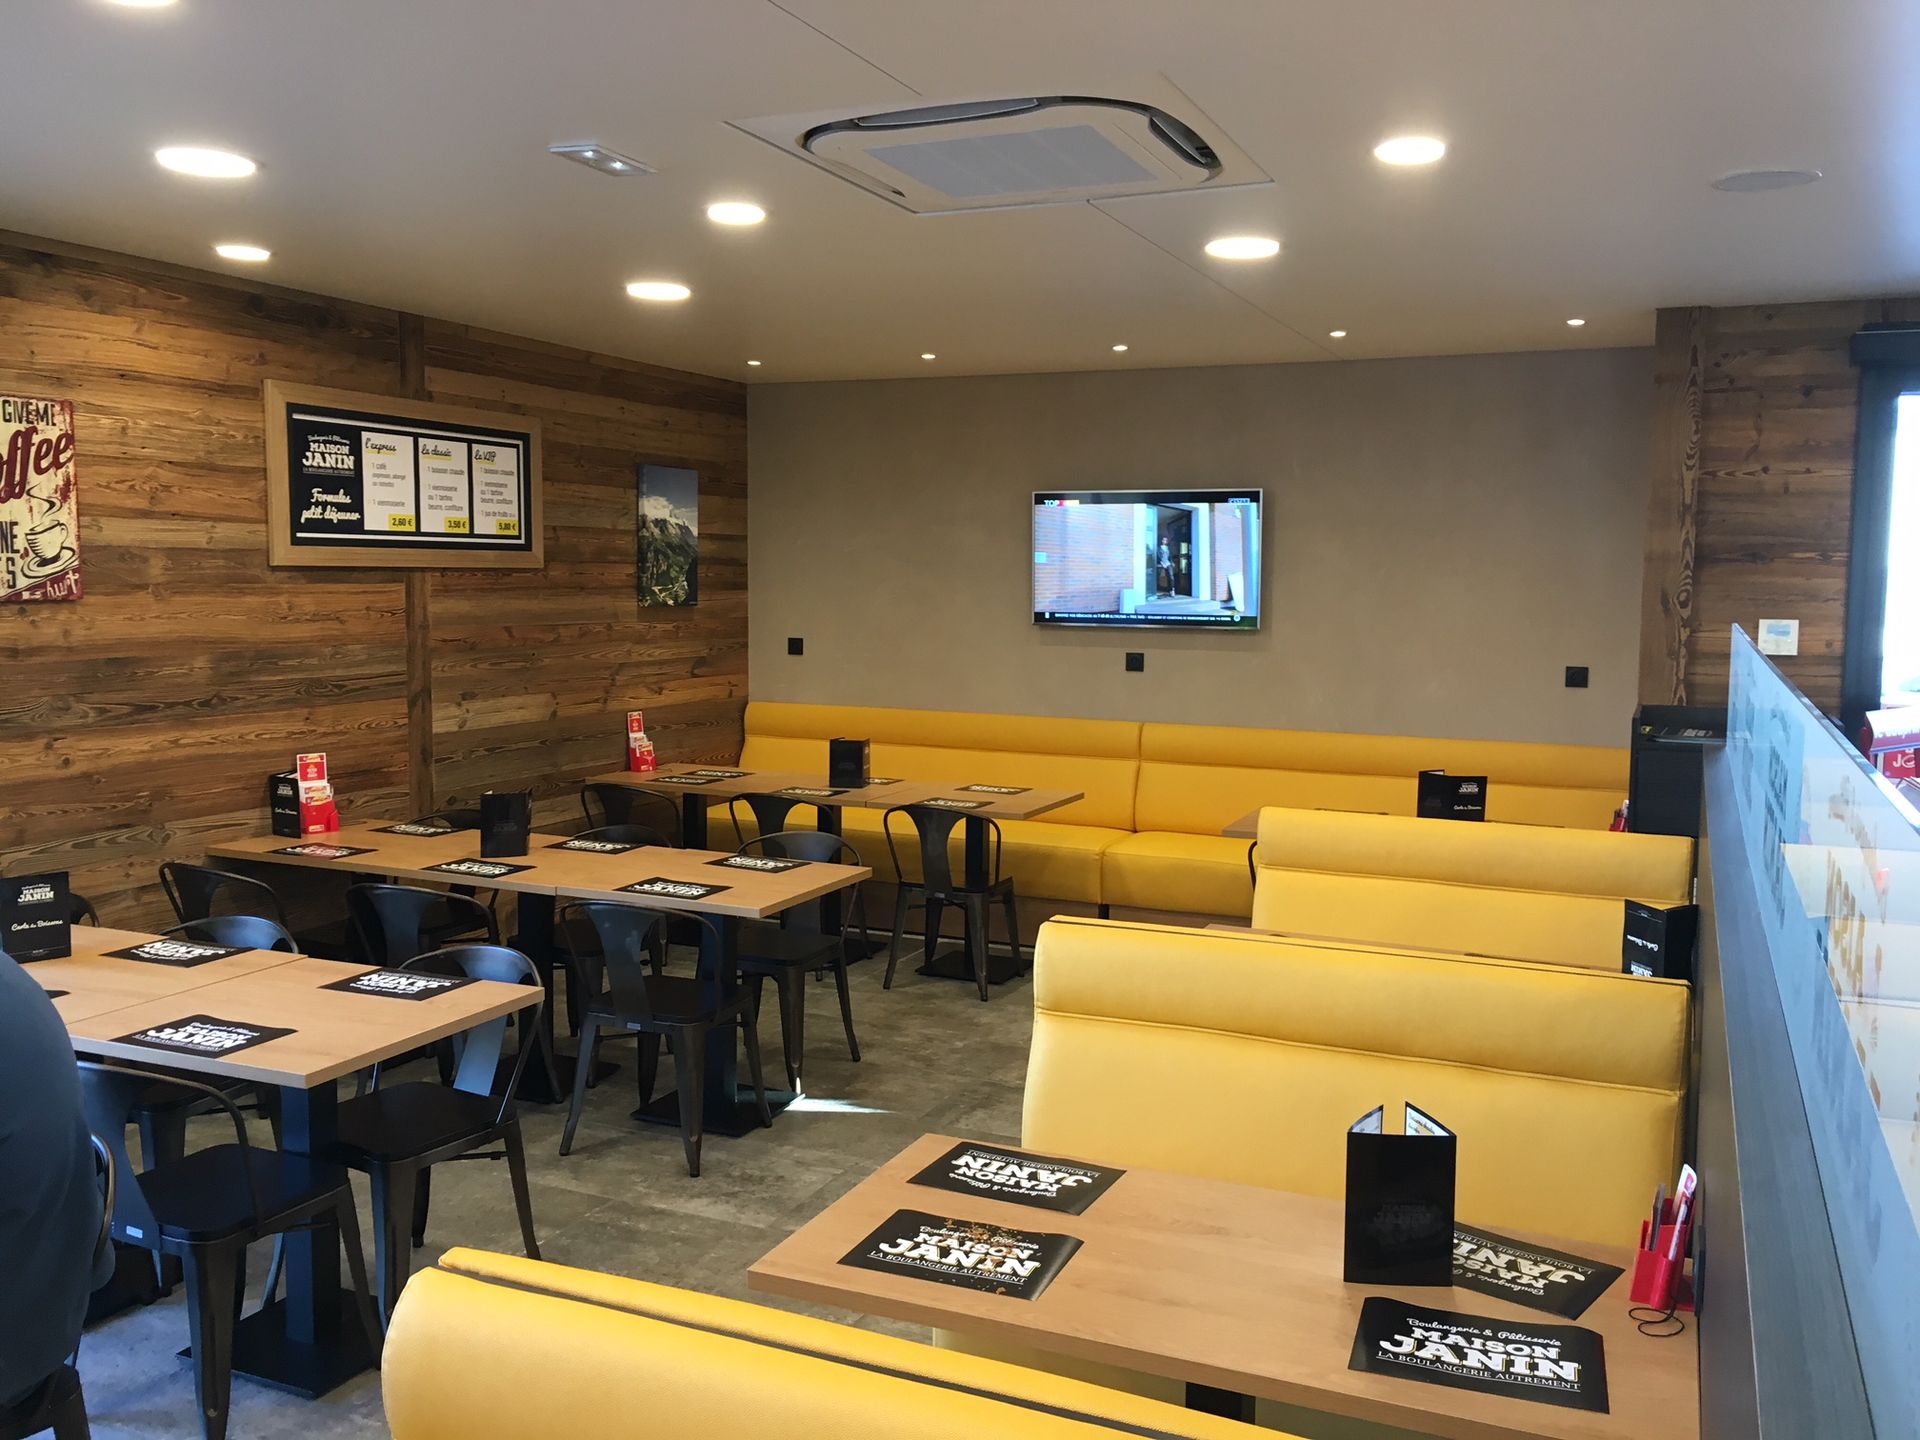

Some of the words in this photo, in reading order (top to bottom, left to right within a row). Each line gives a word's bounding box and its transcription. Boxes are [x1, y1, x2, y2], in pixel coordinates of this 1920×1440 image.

[302, 451, 356, 470] JANIN
[309, 442, 350, 455] MAISON
[0, 425, 75, 504] ffee
[310, 488, 353, 503] Formules
[301, 505, 323, 523] petit
[391, 518, 407, 527] 2,60
[407, 518, 413, 527] €
[17, 891, 54, 902] JANIN
[951, 1155, 1092, 1187] JANIN
[954, 1166, 1062, 1191] MAISON
[879, 1238, 1041, 1277] JANIN
[913, 1233, 1034, 1259] MAISON
[870, 1250, 884, 1259] LA
[887, 1253, 959, 1273] BOULANGERIE
[961, 1267, 1028, 1284] AUTREMENT
[1453, 1239, 1586, 1284] JANI
[1453, 1255, 1549, 1288] MAISO
[1406, 1317, 1481, 1335] Boulangerie
[1498, 1331, 1562, 1346] Pâtisserie
[1411, 1327, 1560, 1359] MAISON
[1378, 1350, 1394, 1360] LA
[1399, 1355, 1492, 1377] BOULANGERIE
[1495, 1373, 1581, 1390] AUTREMENT
[1379, 1334, 1582, 1382] JANIN
